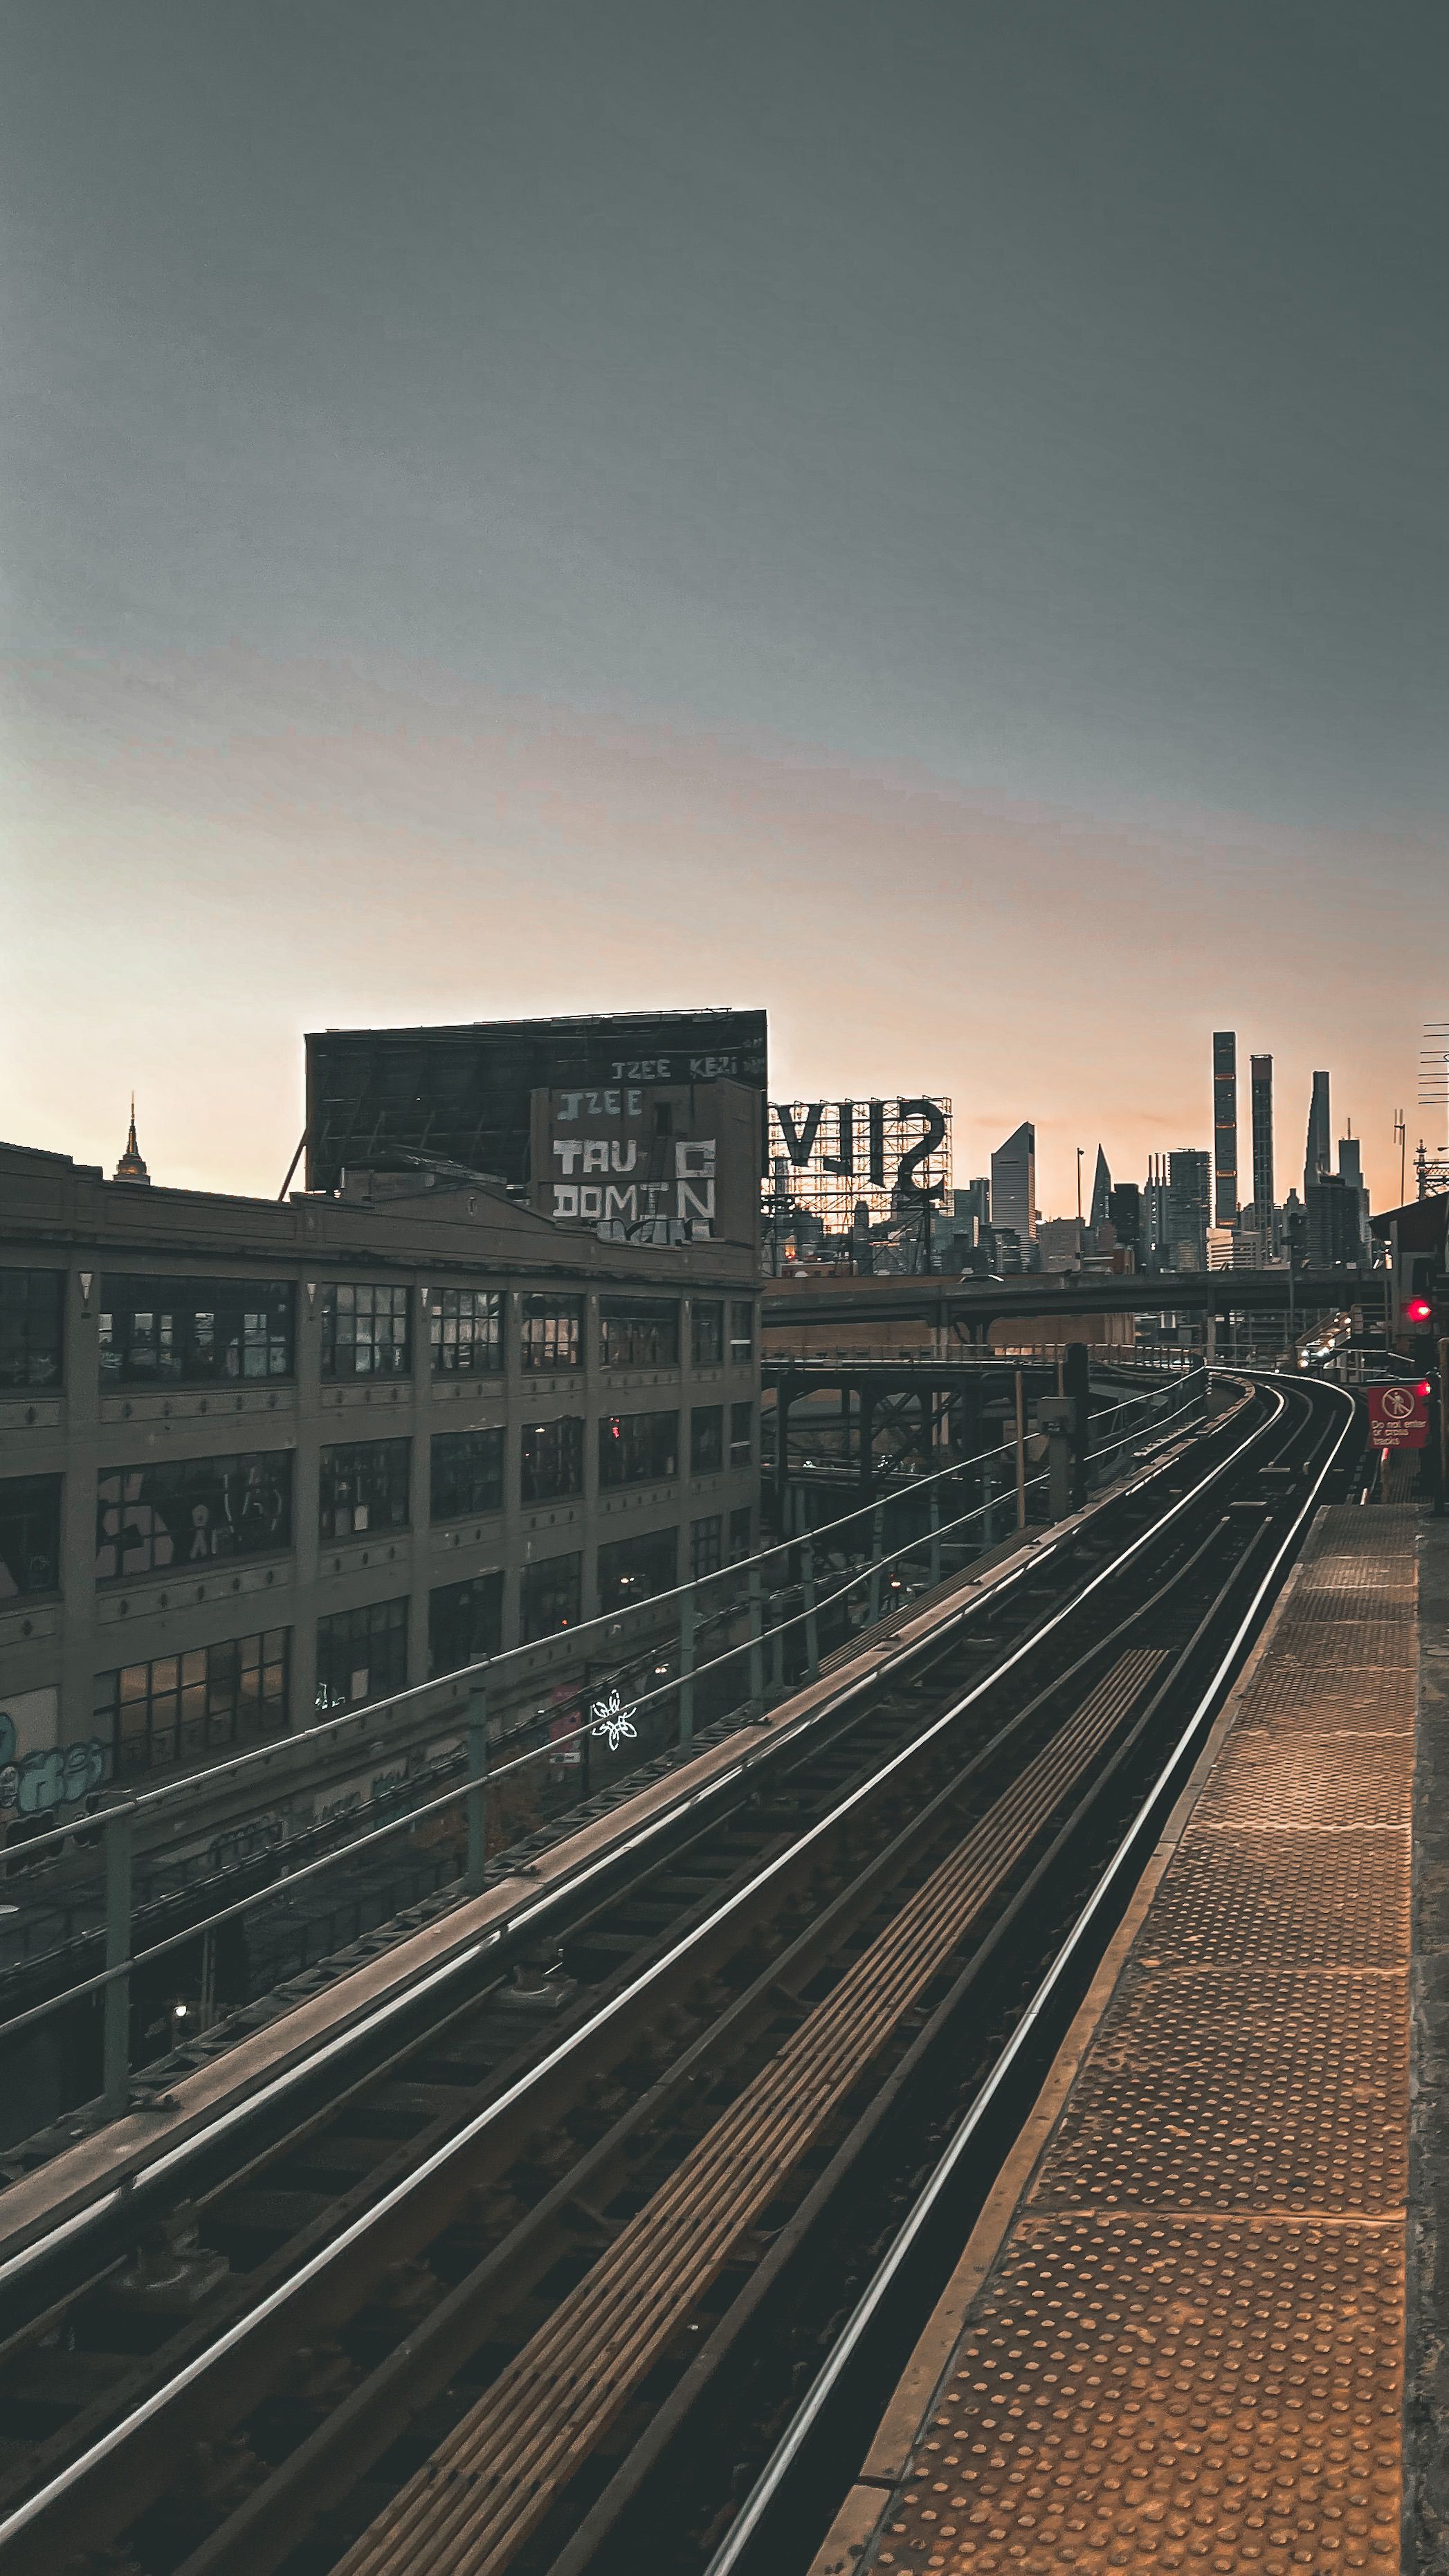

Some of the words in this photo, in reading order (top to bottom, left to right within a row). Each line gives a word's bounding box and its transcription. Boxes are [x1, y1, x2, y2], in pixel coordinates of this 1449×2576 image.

[557, 1090, 643, 1121] JZEE
[1371, 1421, 1385, 1429] Do
[1387, 1420, 1401, 1428] not
[1404, 1420, 1428, 1428] enter
[1385, 1428, 1409, 1436] cross
[1373, 1436, 1401, 1445] tracks
